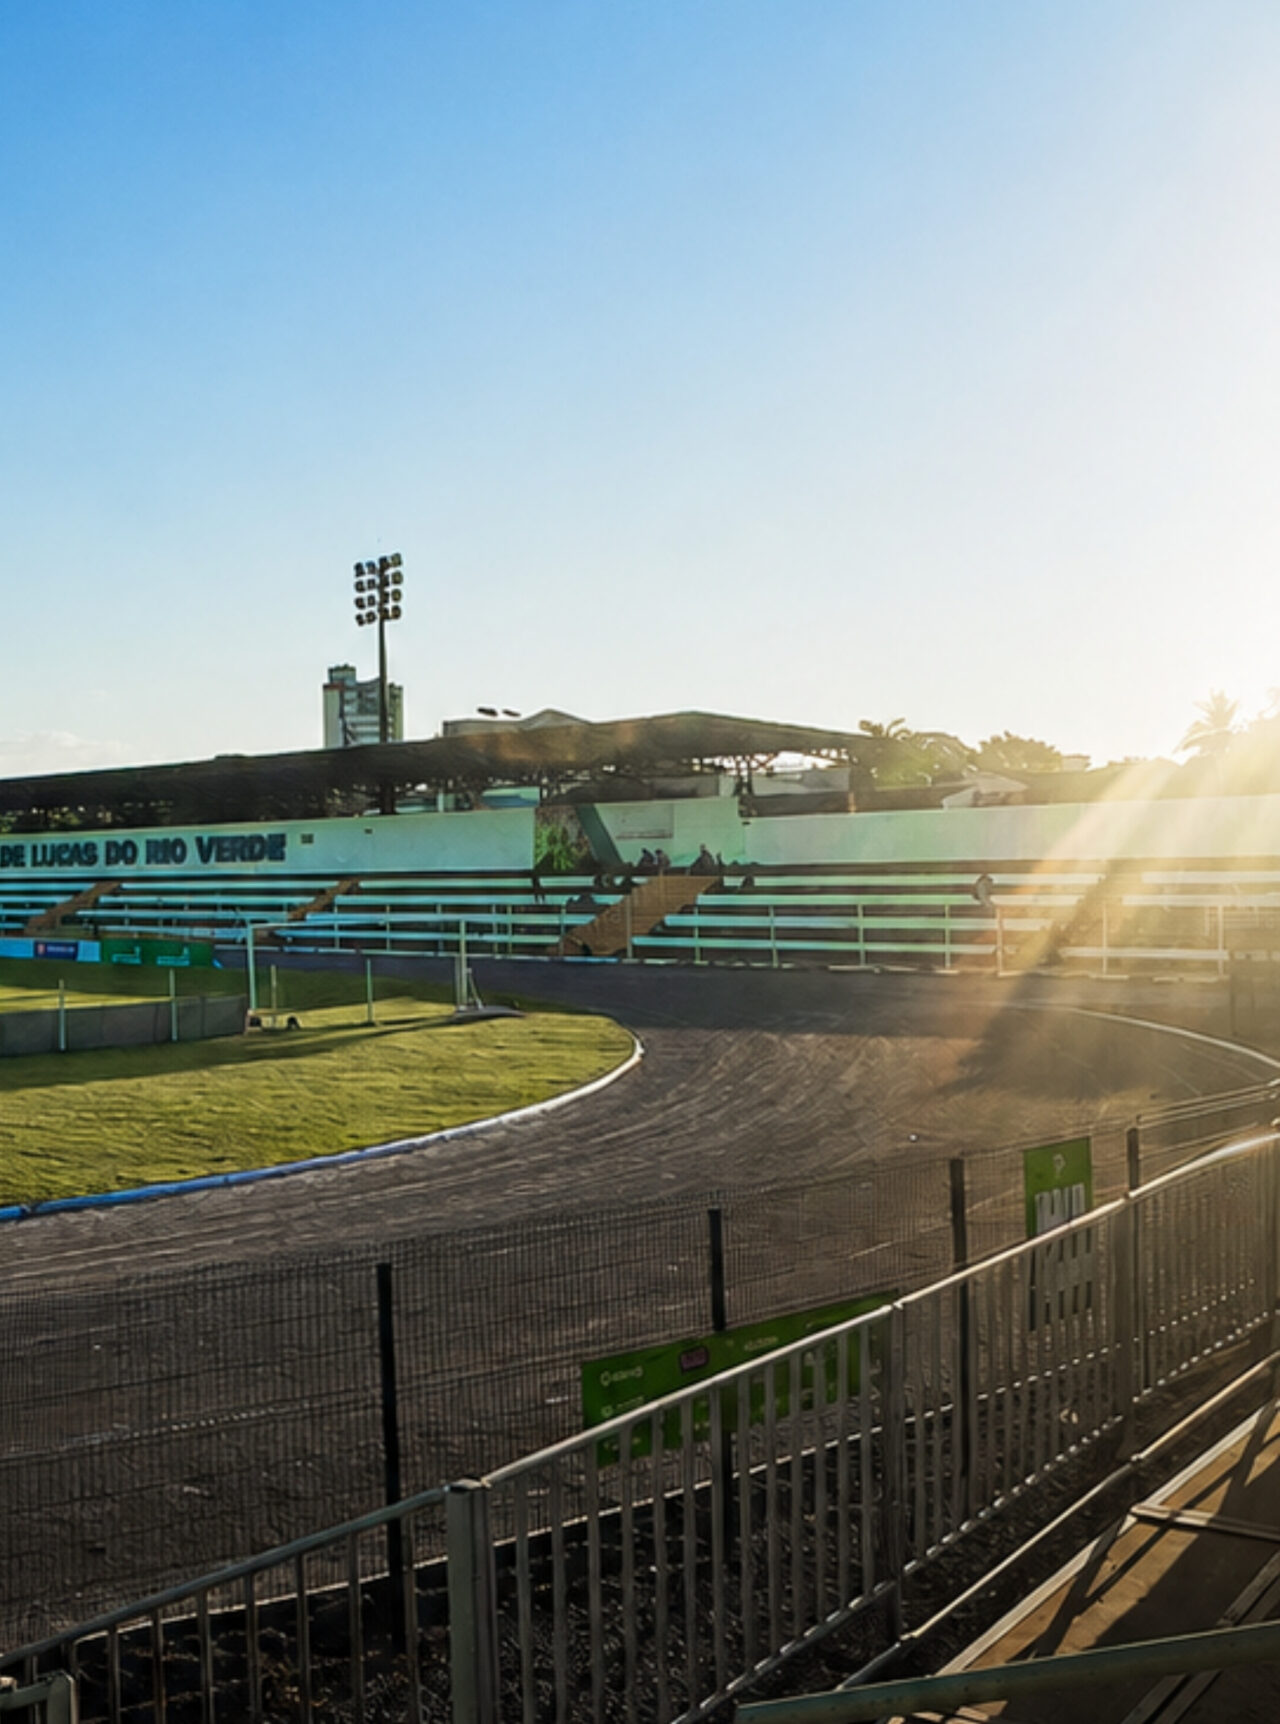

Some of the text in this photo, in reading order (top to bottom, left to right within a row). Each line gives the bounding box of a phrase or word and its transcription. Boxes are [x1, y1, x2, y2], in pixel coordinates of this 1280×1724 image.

[0, 845, 26, 868] DE
[31, 841, 98, 867] LUCAS
[105, 839, 137, 866] DO
[146, 837, 187, 865] RIO
[195, 833, 287, 864] VERDE
